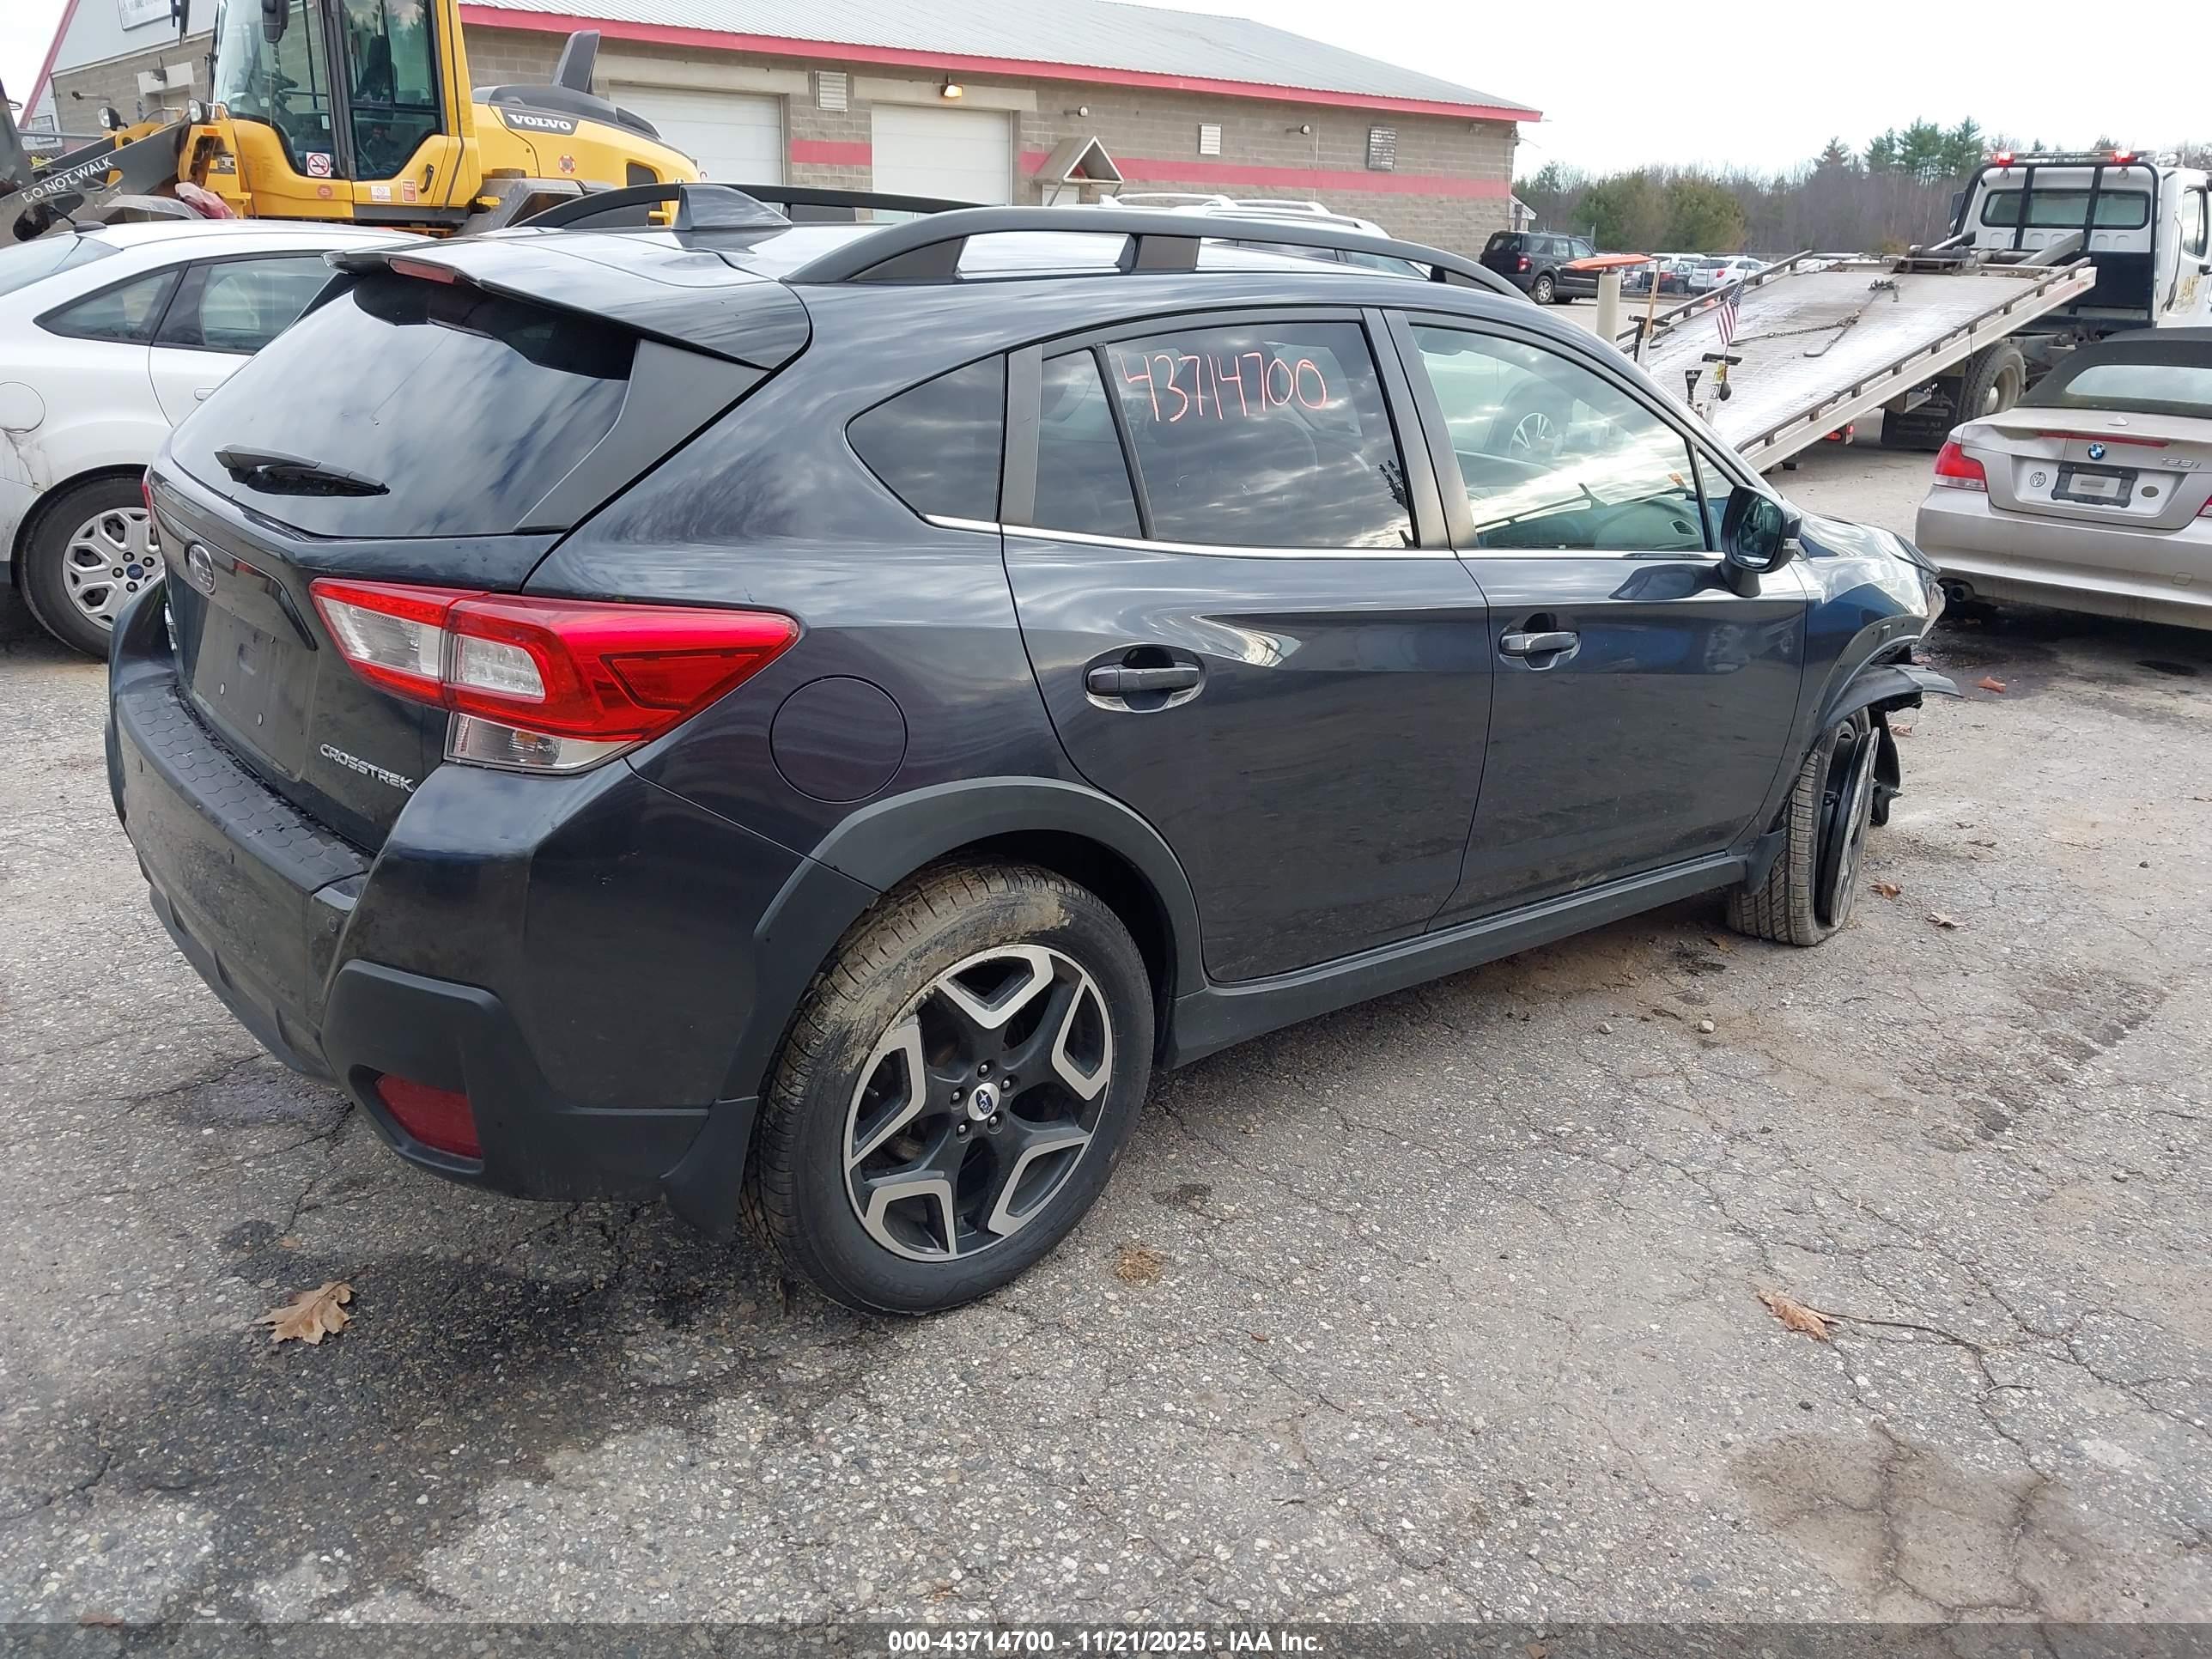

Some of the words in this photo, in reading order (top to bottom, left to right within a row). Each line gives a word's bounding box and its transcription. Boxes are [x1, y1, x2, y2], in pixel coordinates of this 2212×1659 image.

[507, 113, 572, 131] VOLVO
[21, 187, 43, 204] DO
[45, 173, 73, 193] NOT
[74, 157, 114, 179] WALK
[1117, 351, 1328, 422] 43714700
[319, 743, 416, 793] CROSSTREK
